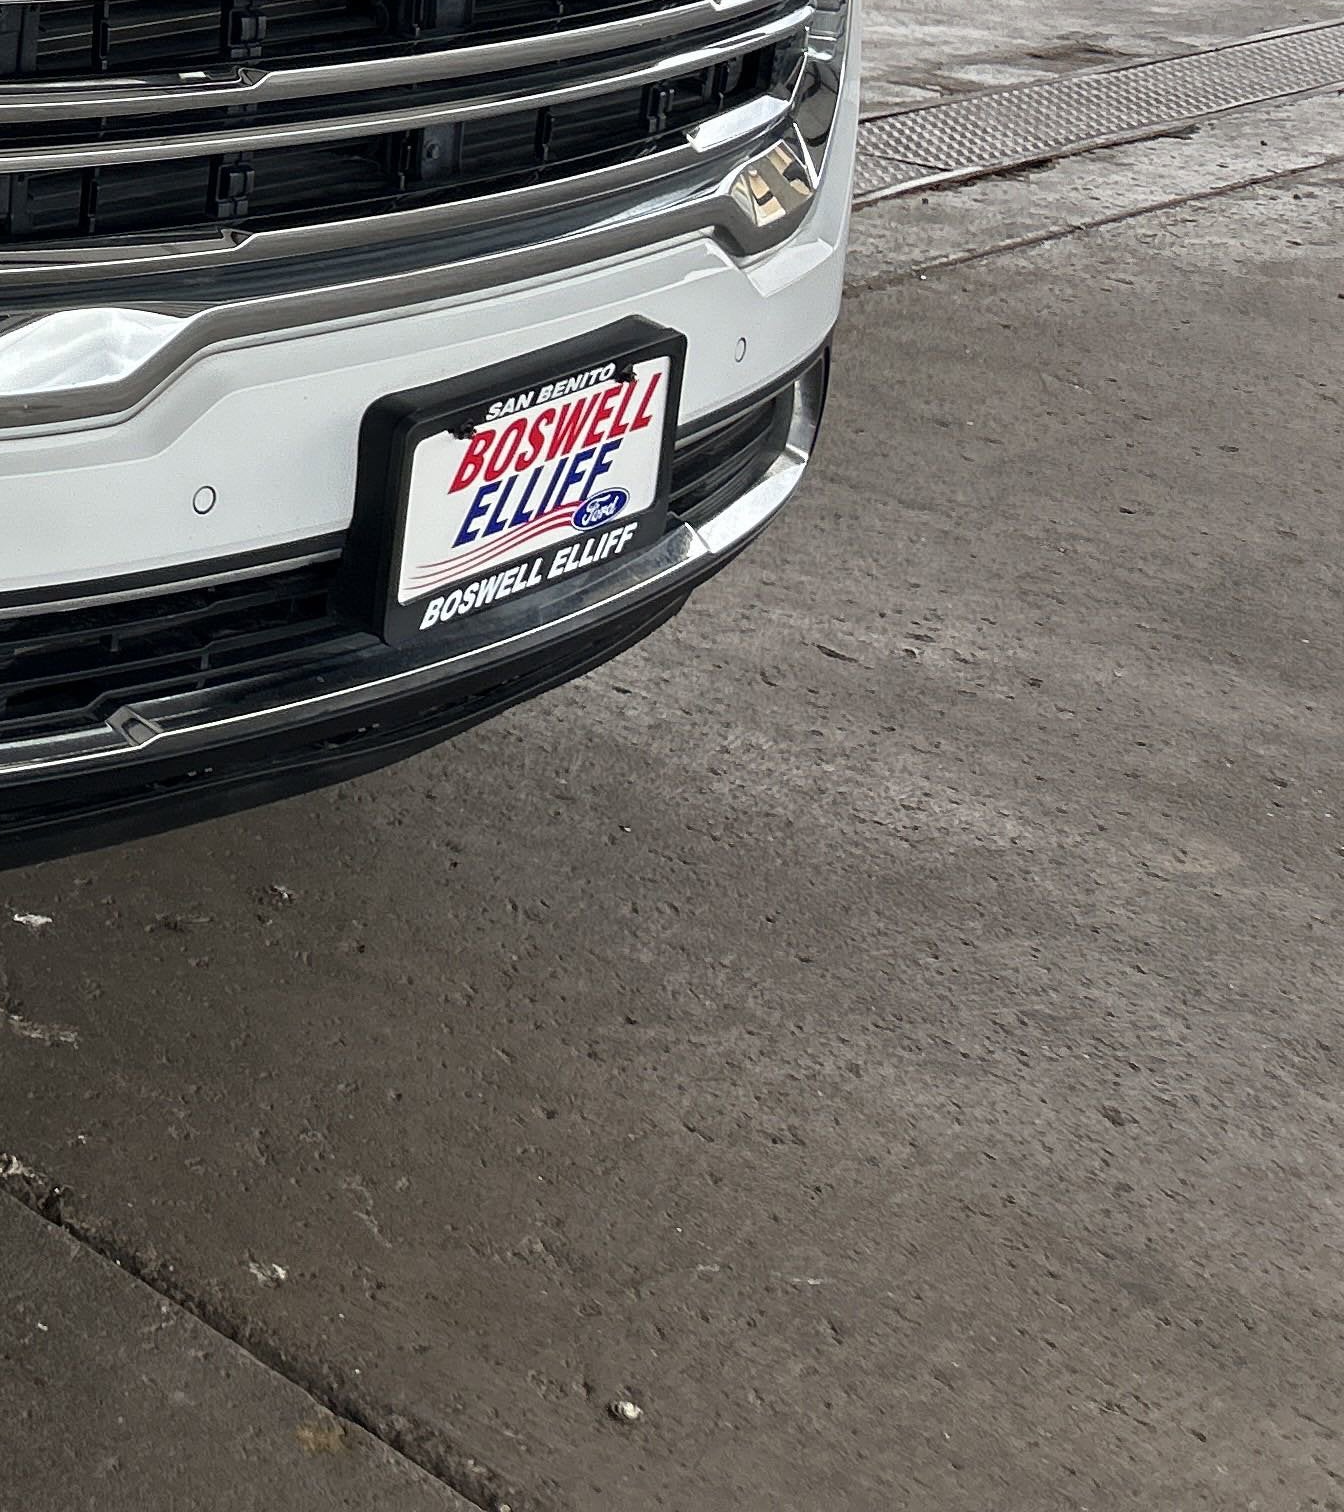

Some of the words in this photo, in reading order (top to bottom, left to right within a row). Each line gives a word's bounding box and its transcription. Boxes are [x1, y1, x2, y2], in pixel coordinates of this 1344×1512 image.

[447, 372, 663, 495] BOSWELL
[485, 388, 532, 421] SAN
[535, 362, 617, 401] BENITO
[451, 438, 624, 548] ELLIFF
[580, 494, 620, 528] Ford
[419, 556, 545, 631] BOSWELL
[547, 521, 638, 580] ELLIFF
